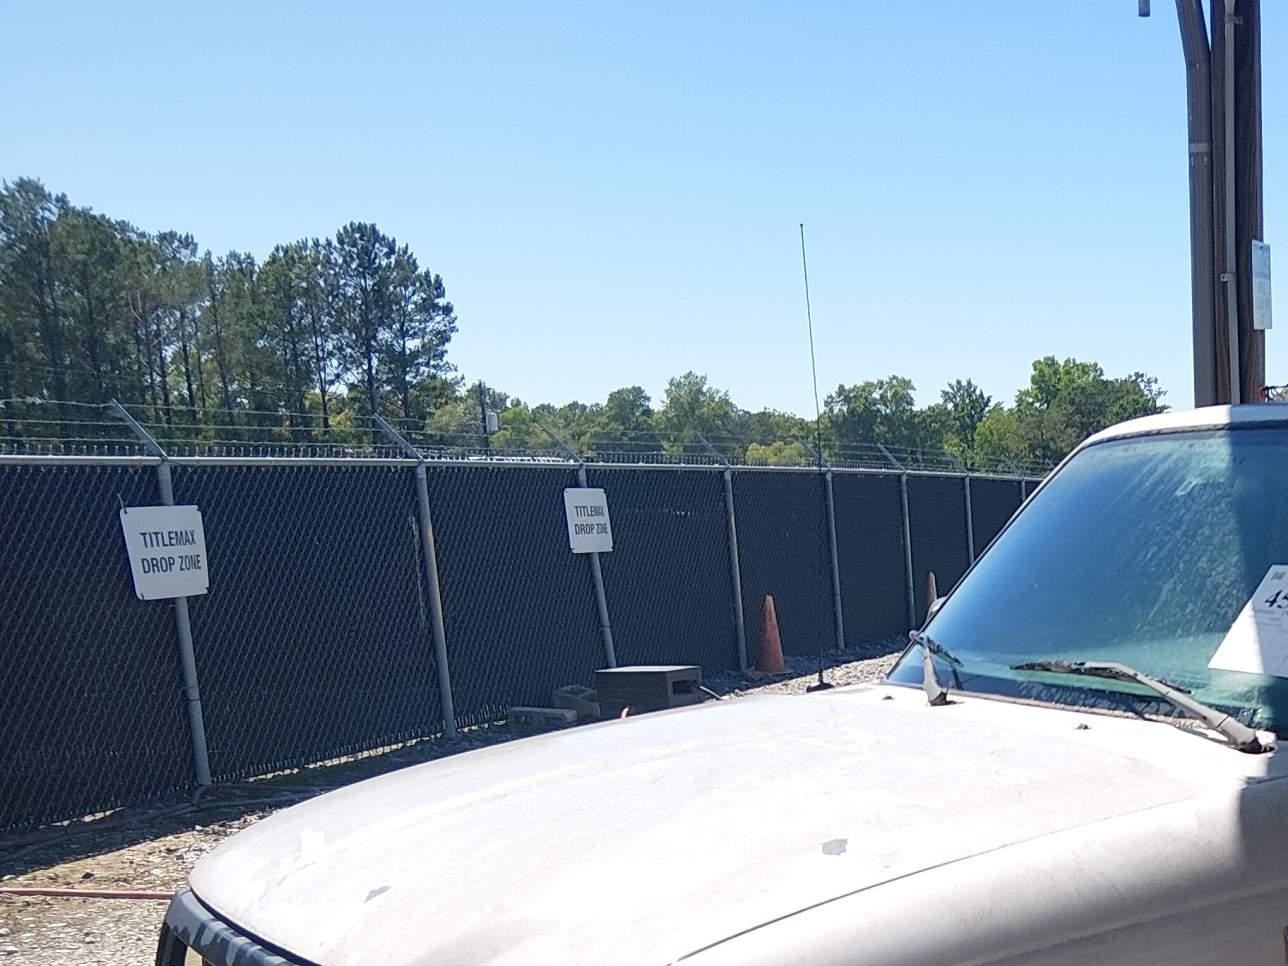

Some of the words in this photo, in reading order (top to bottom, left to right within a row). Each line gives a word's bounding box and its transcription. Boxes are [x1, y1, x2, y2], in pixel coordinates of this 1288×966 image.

[574, 523, 595, 535] DROP
[139, 530, 196, 548] TITLEMAX
[141, 557, 175, 573] DROP
[178, 554, 202, 571] ZONE
